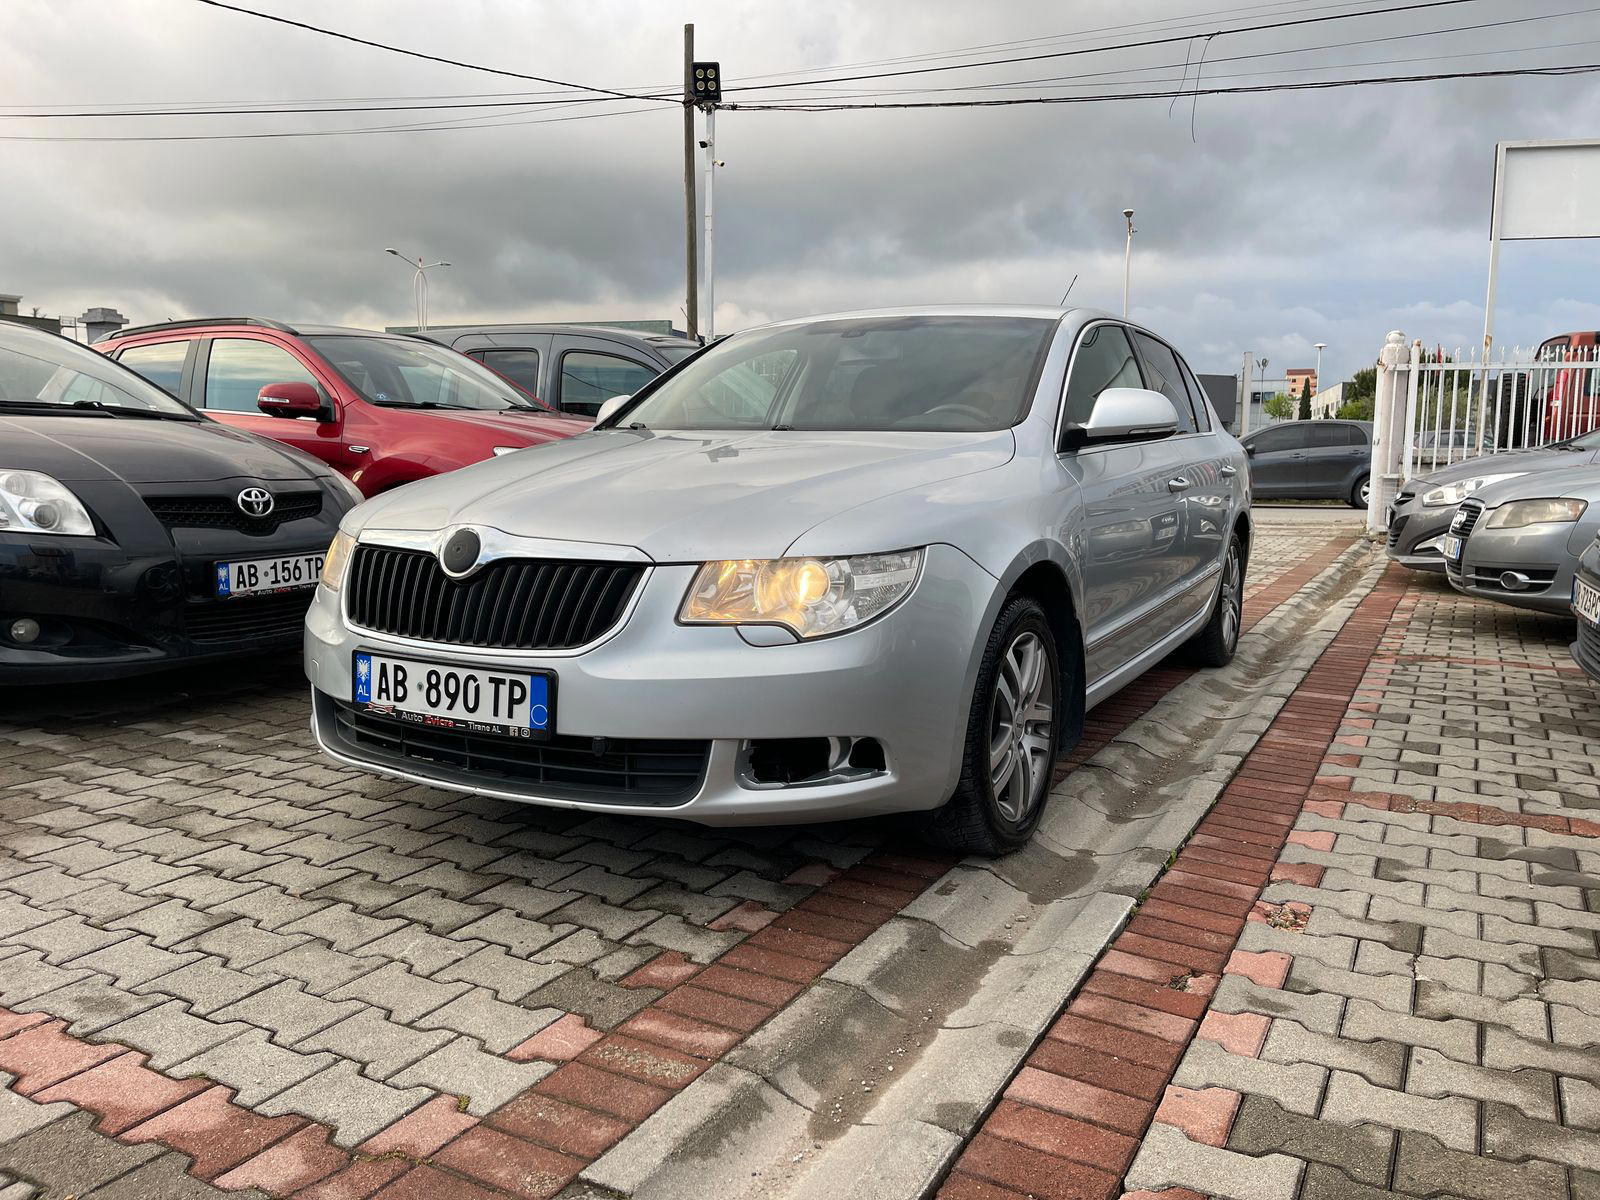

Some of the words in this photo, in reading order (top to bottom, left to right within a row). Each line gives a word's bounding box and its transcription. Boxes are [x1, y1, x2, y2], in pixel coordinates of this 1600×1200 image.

[236, 564, 259, 589] AB
[270, 559, 302, 585] 156
[305, 557, 323, 580] TP
[219, 583, 229, 591] AL
[357, 684, 369, 696] AL
[377, 662, 408, 702] AB
[425, 669, 480, 713] 890
[488, 676, 527, 719] TP
[401, 711, 423, 722] Auto
[492, 725, 501, 733] AL
